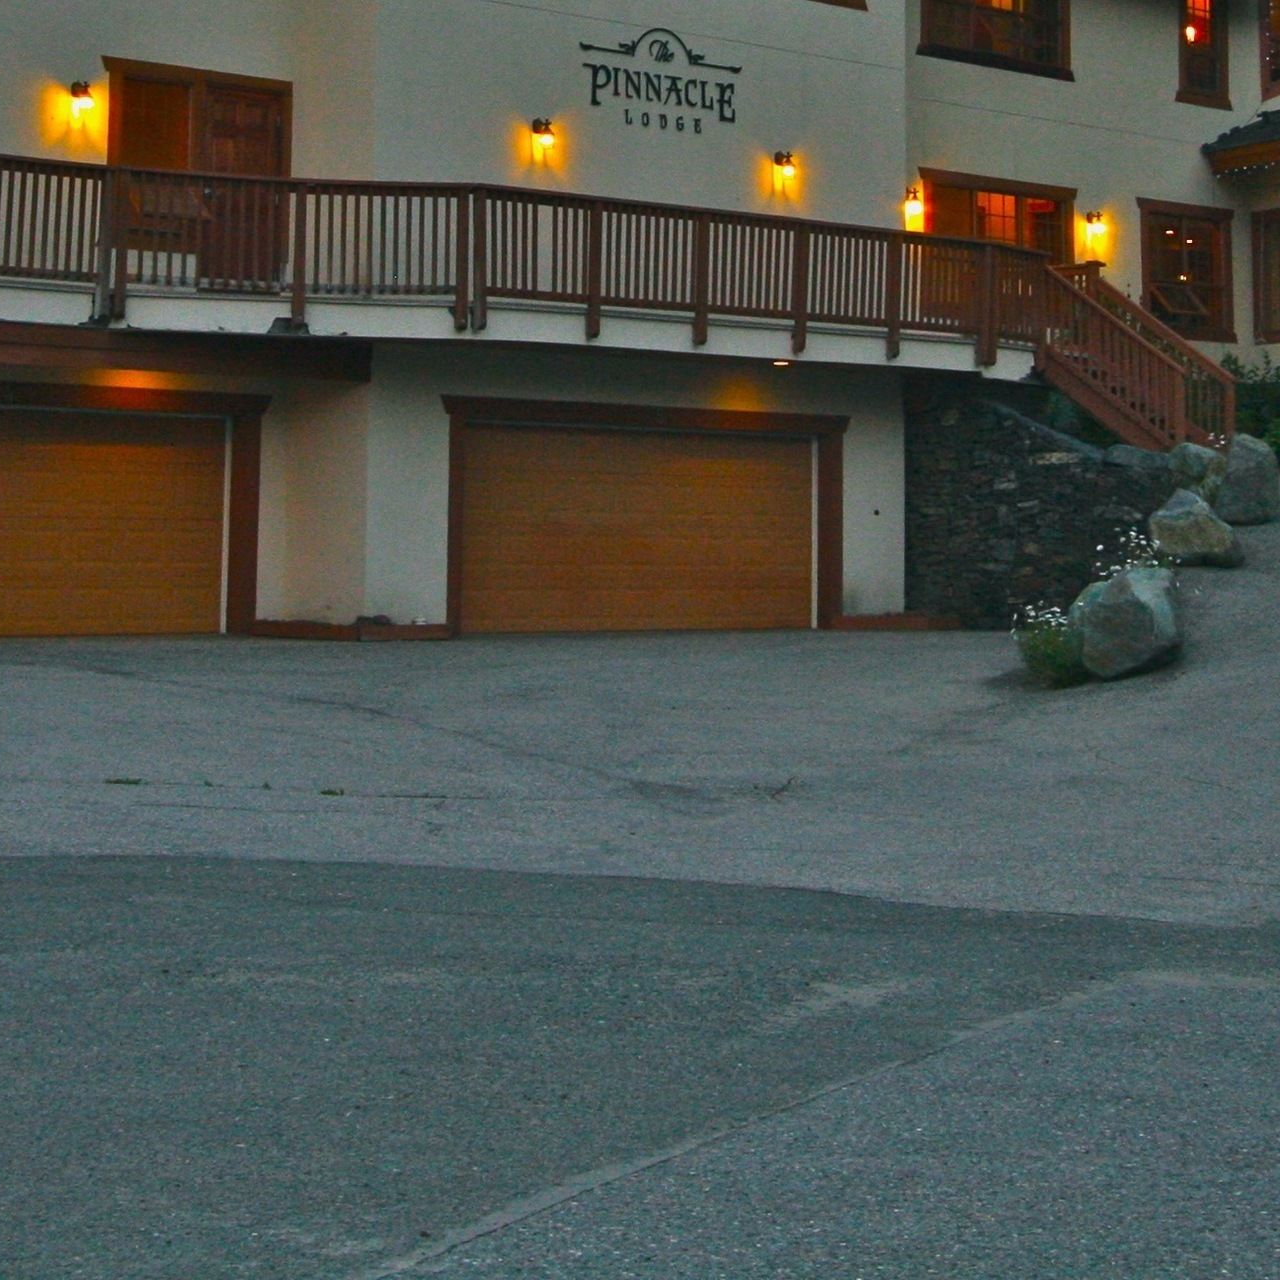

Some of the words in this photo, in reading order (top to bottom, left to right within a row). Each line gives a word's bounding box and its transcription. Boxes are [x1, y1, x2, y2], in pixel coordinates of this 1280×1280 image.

[649, 39, 675, 63] The
[582, 63, 736, 124] PINNACLE
[624, 109, 702, 134] LODGE
